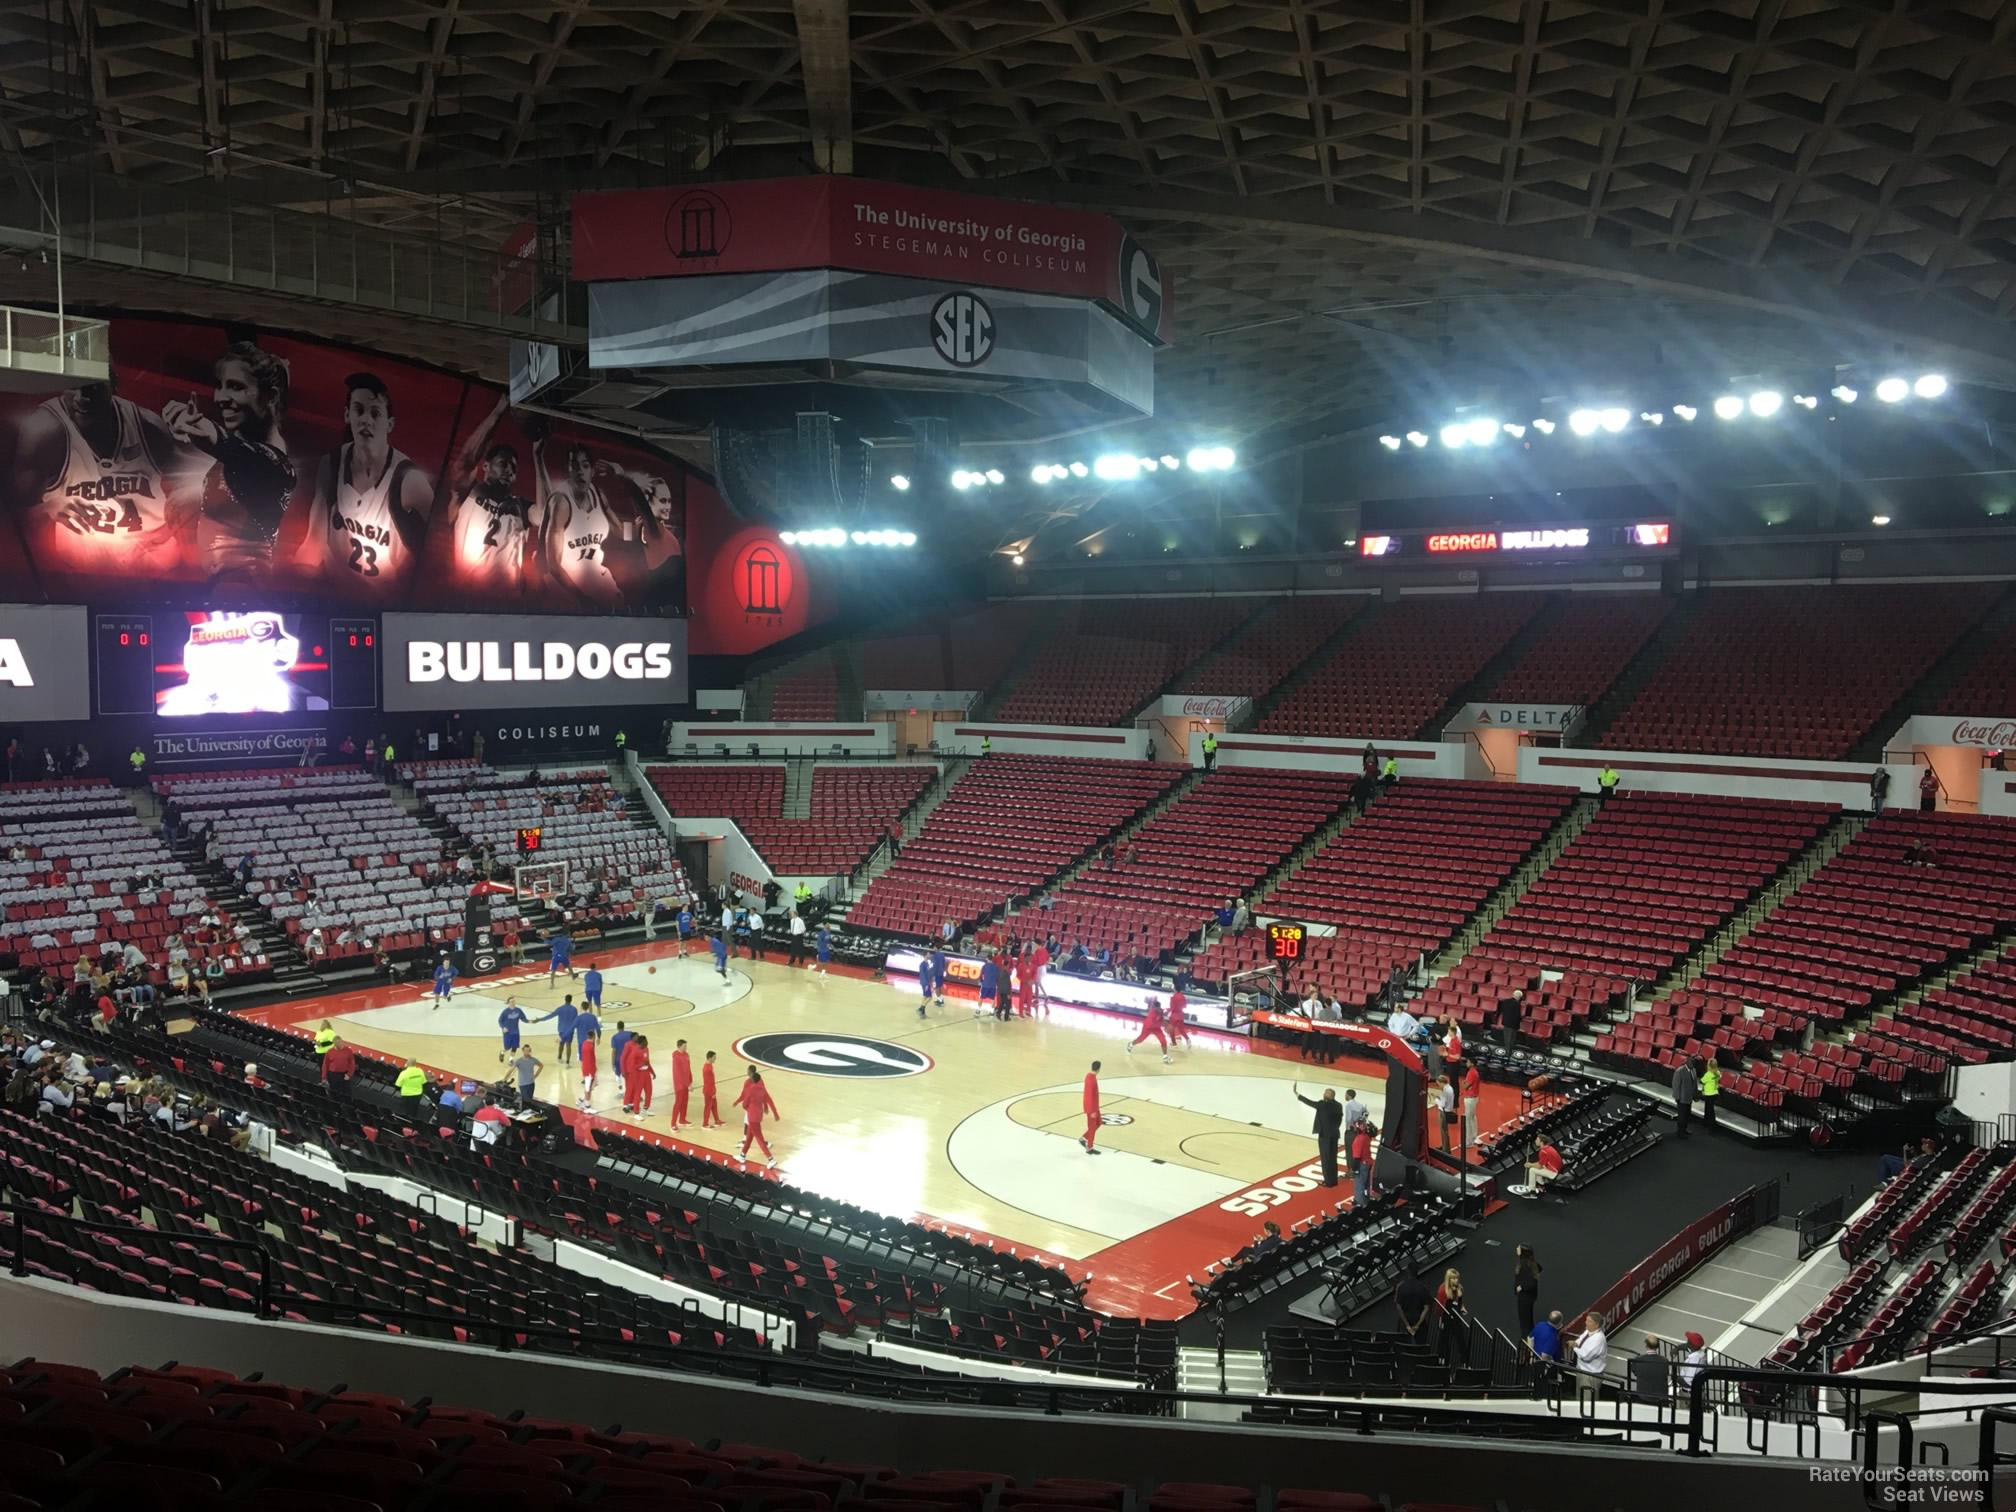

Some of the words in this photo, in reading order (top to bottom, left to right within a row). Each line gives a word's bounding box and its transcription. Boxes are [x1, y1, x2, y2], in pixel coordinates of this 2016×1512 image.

[853, 204, 889, 224] The
[895, 210, 989, 242] University
[995, 224, 1013, 241] of
[1018, 227, 1086, 252] Georgia
[854, 232, 968, 259] STEGEMAN
[983, 249, 1087, 273] COLISEUM
[934, 295, 992, 363] SEC
[484, 518, 500, 547] 2
[1429, 533, 1497, 551] GEORGIA
[349, 538, 379, 576] 23
[121, 633, 129, 645] 0
[140, 634, 148, 645] 0
[350, 635, 357, 646] 0
[365, 635, 372, 646] 0
[408, 641, 672, 682] BULLDOGS
[154, 739, 185, 754] The
[187, 737, 256, 754] University
[257, 734, 272, 749] of
[498, 725, 600, 740] COLISEUM
[1275, 938, 1298, 957] 30
[1632, 1281, 1645, 1304] OF
[1649, 1245, 1691, 1291] GEORGIA
